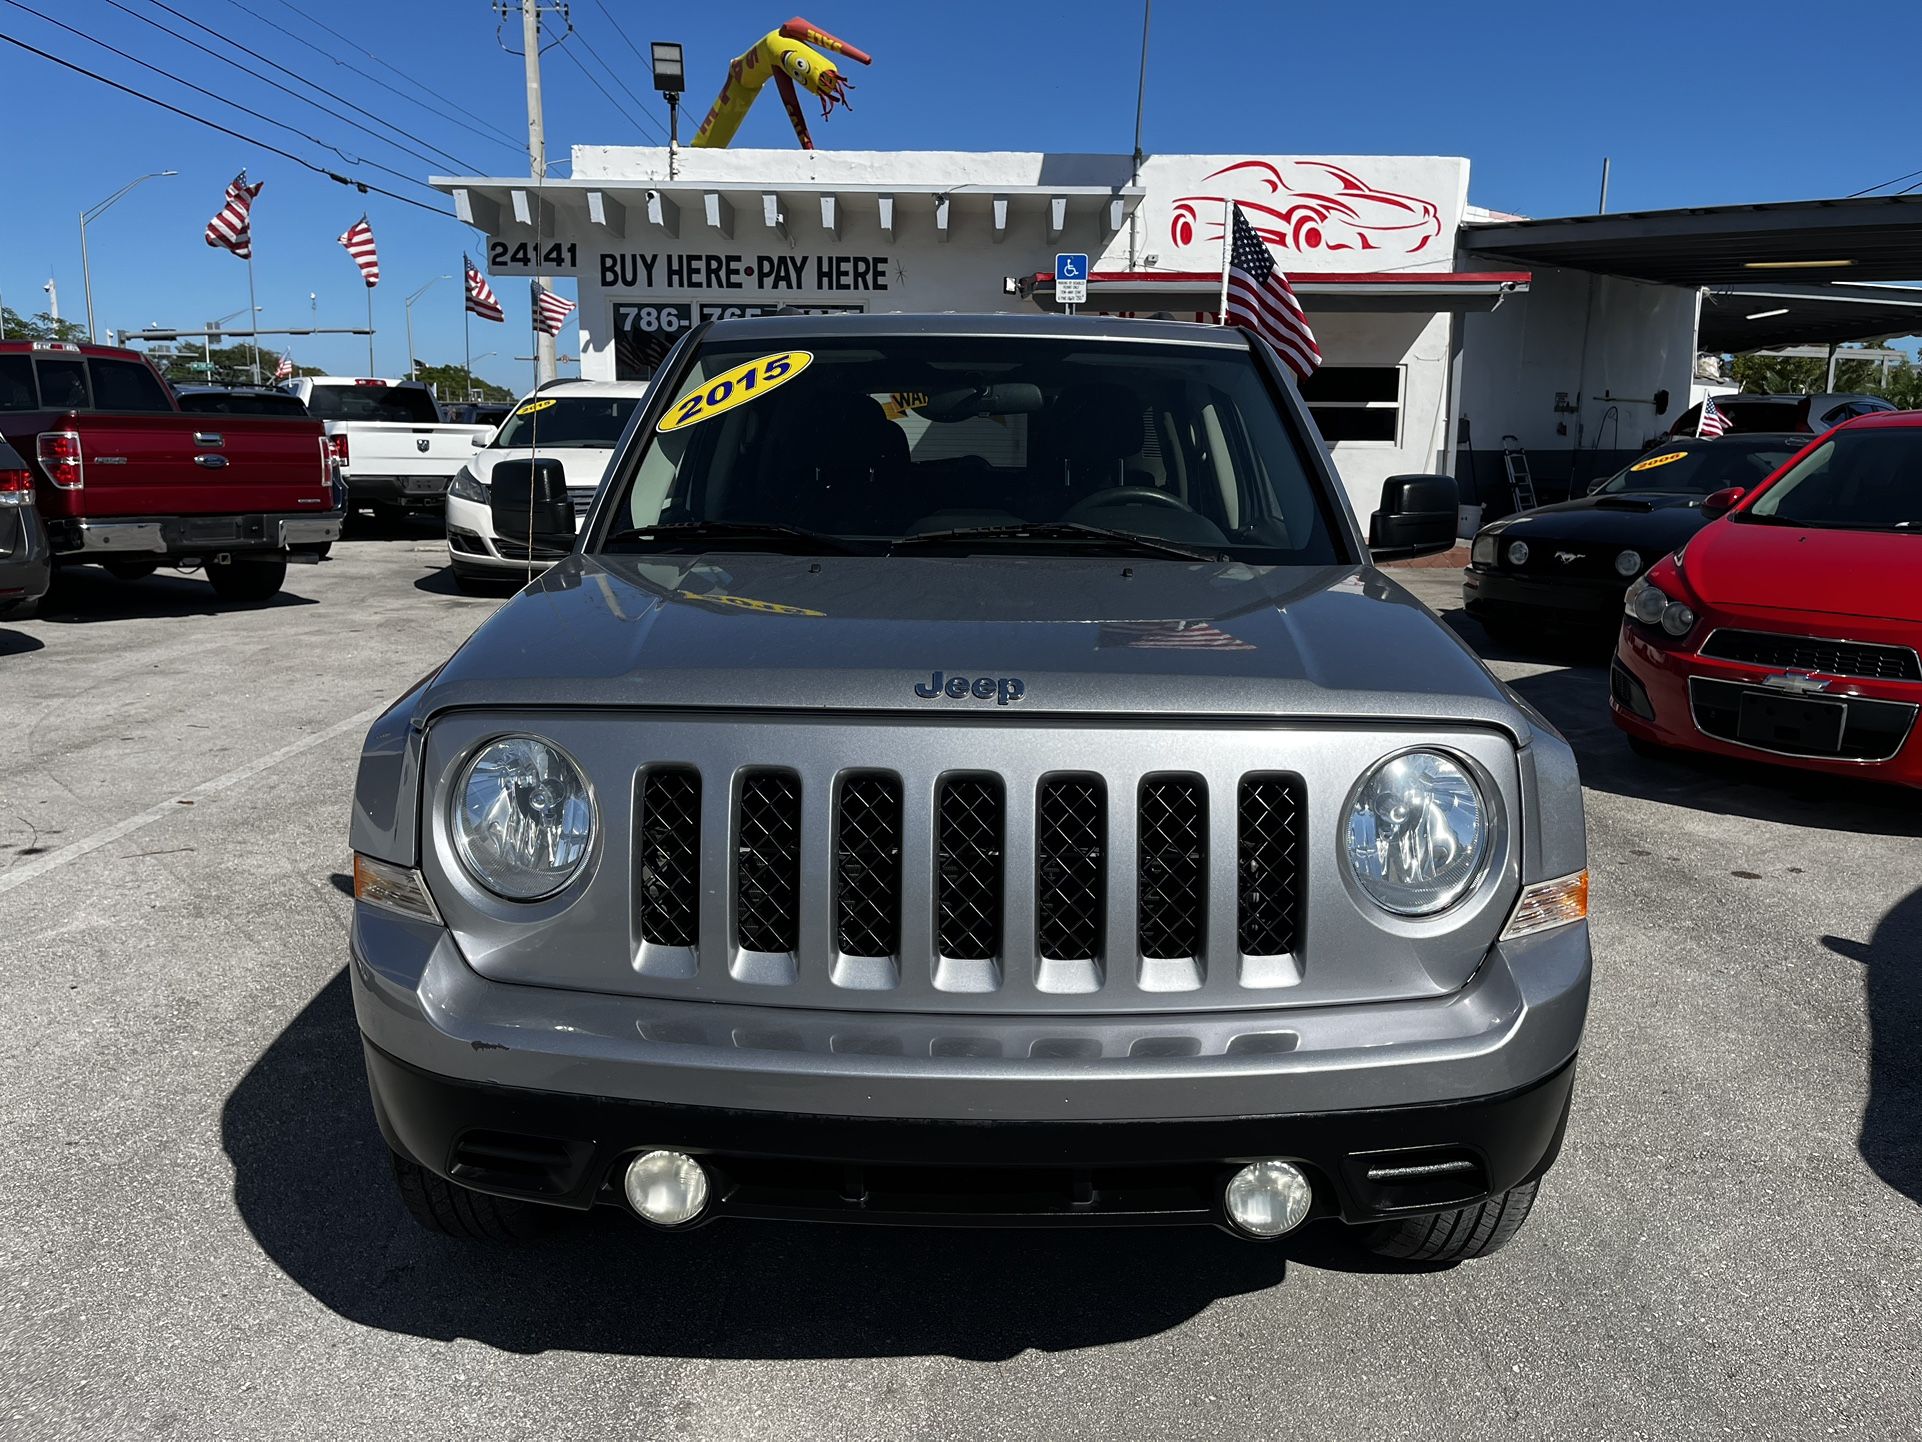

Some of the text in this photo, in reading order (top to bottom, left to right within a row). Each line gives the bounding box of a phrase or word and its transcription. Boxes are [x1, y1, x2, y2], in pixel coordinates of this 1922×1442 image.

[490, 241, 577, 268] 24141
[600, 253, 889, 291] BUY HERE PAY HERE
[619, 306, 691, 332] 786-
[676, 354, 803, 426] 2015
[914, 671, 1026, 706] Jeep
